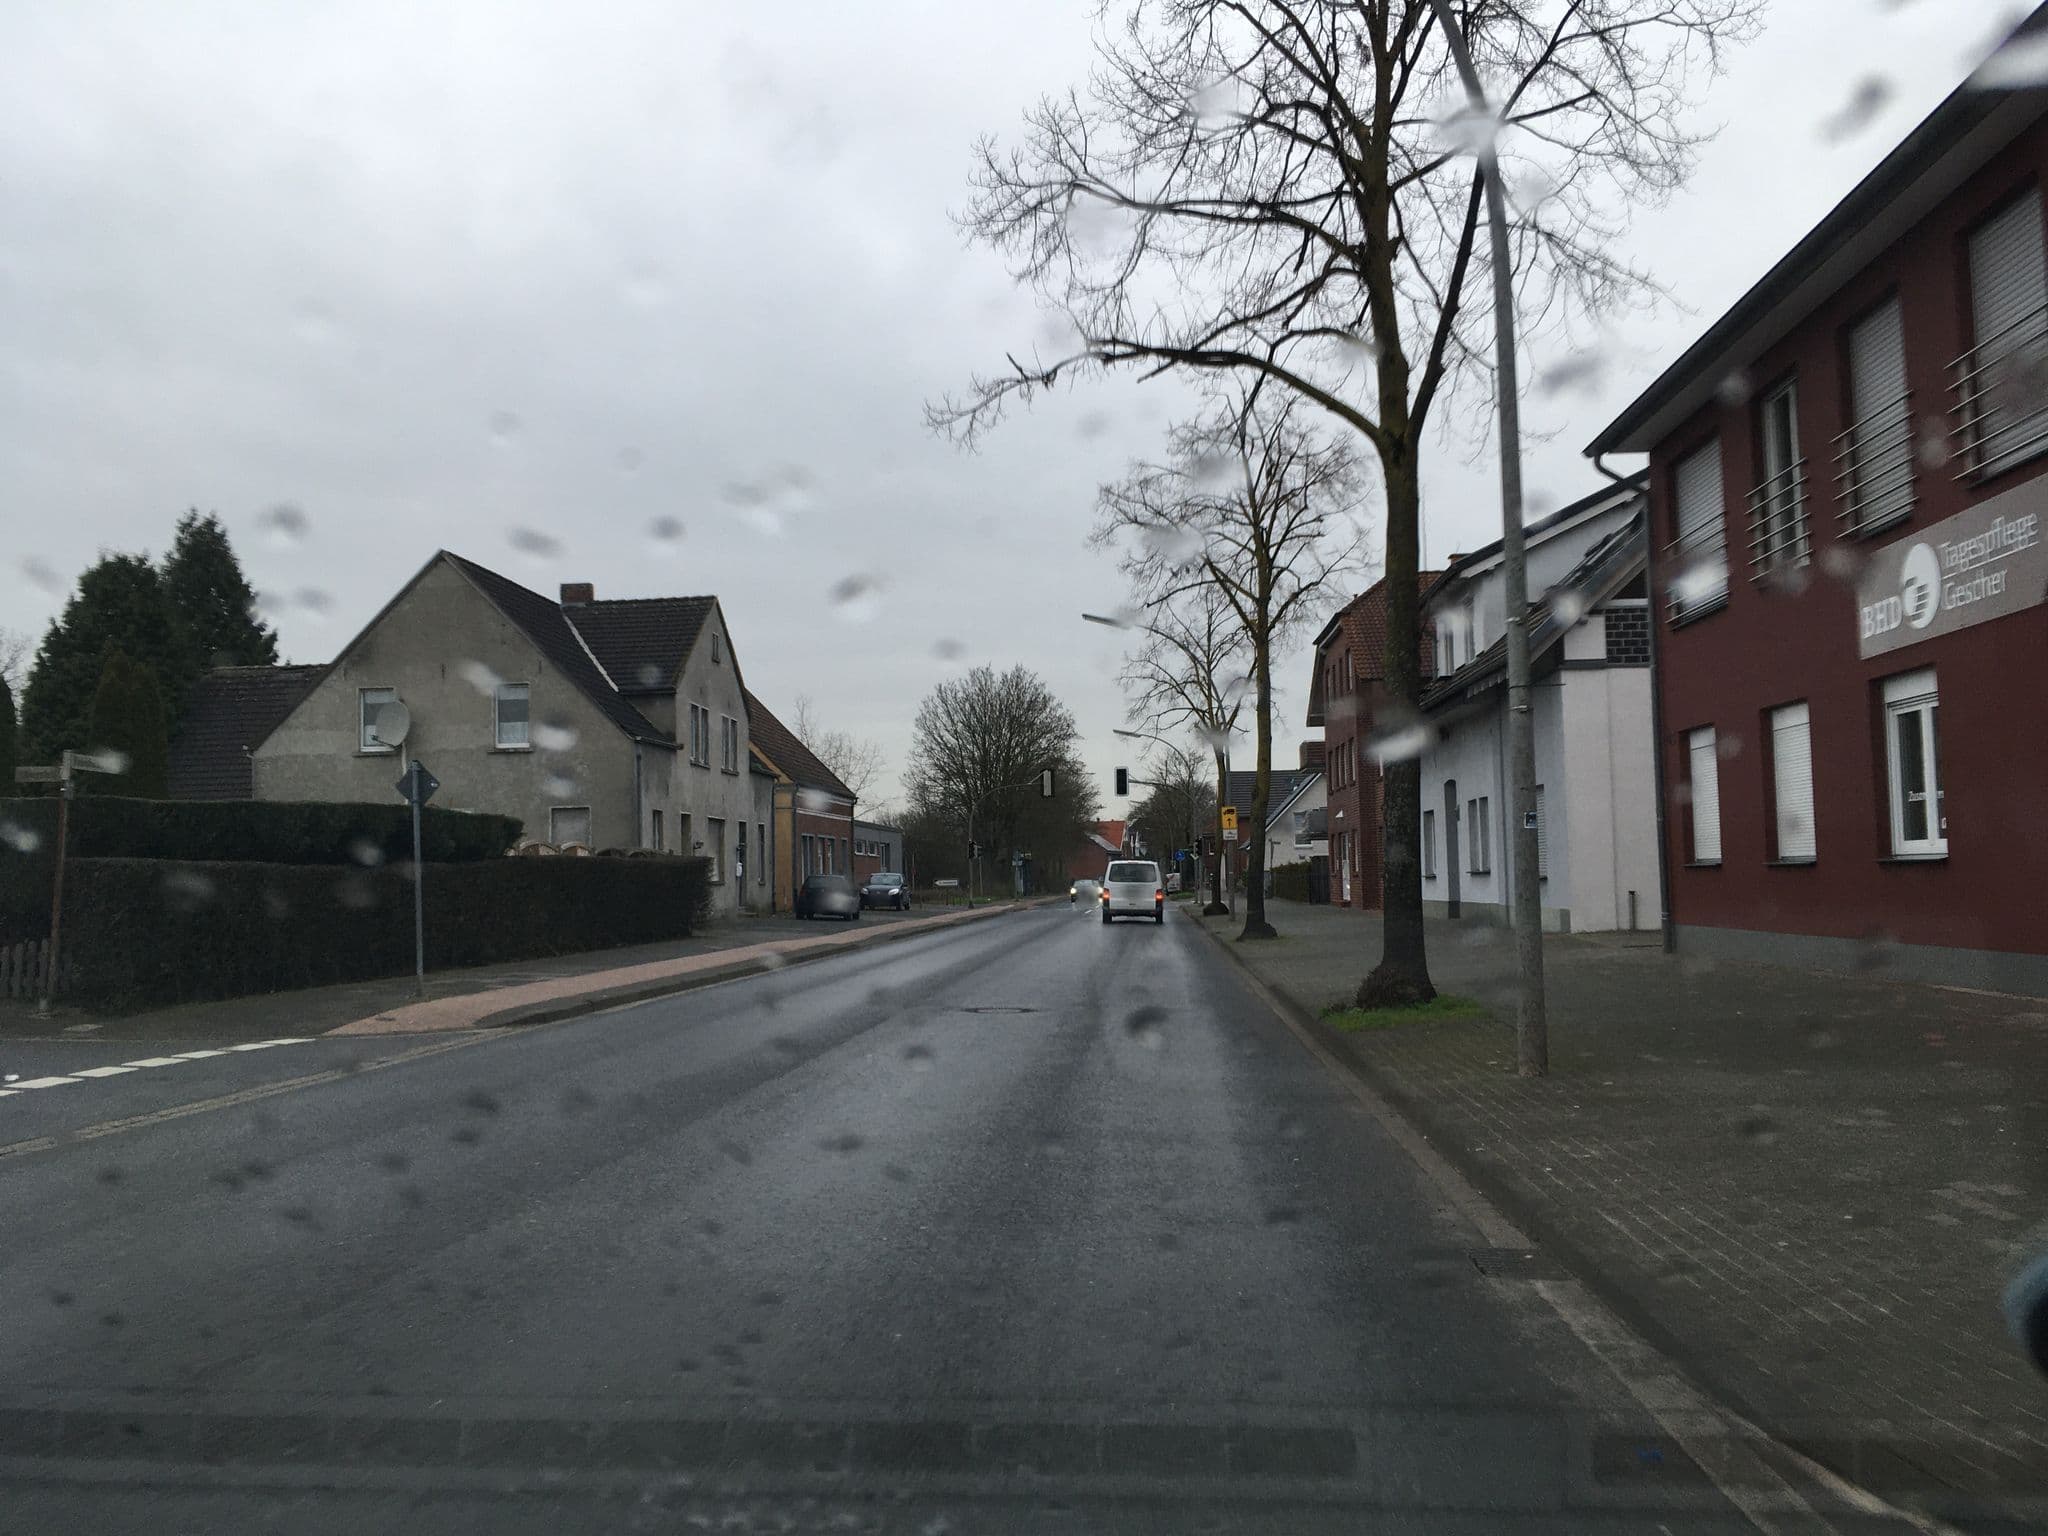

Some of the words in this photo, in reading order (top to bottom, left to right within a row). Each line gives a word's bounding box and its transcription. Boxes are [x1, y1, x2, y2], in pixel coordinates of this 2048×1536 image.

[1939, 512, 2040, 571] Tagespflege
[1944, 568, 2008, 611] Gescher
[1862, 596, 1903, 639] BHD
